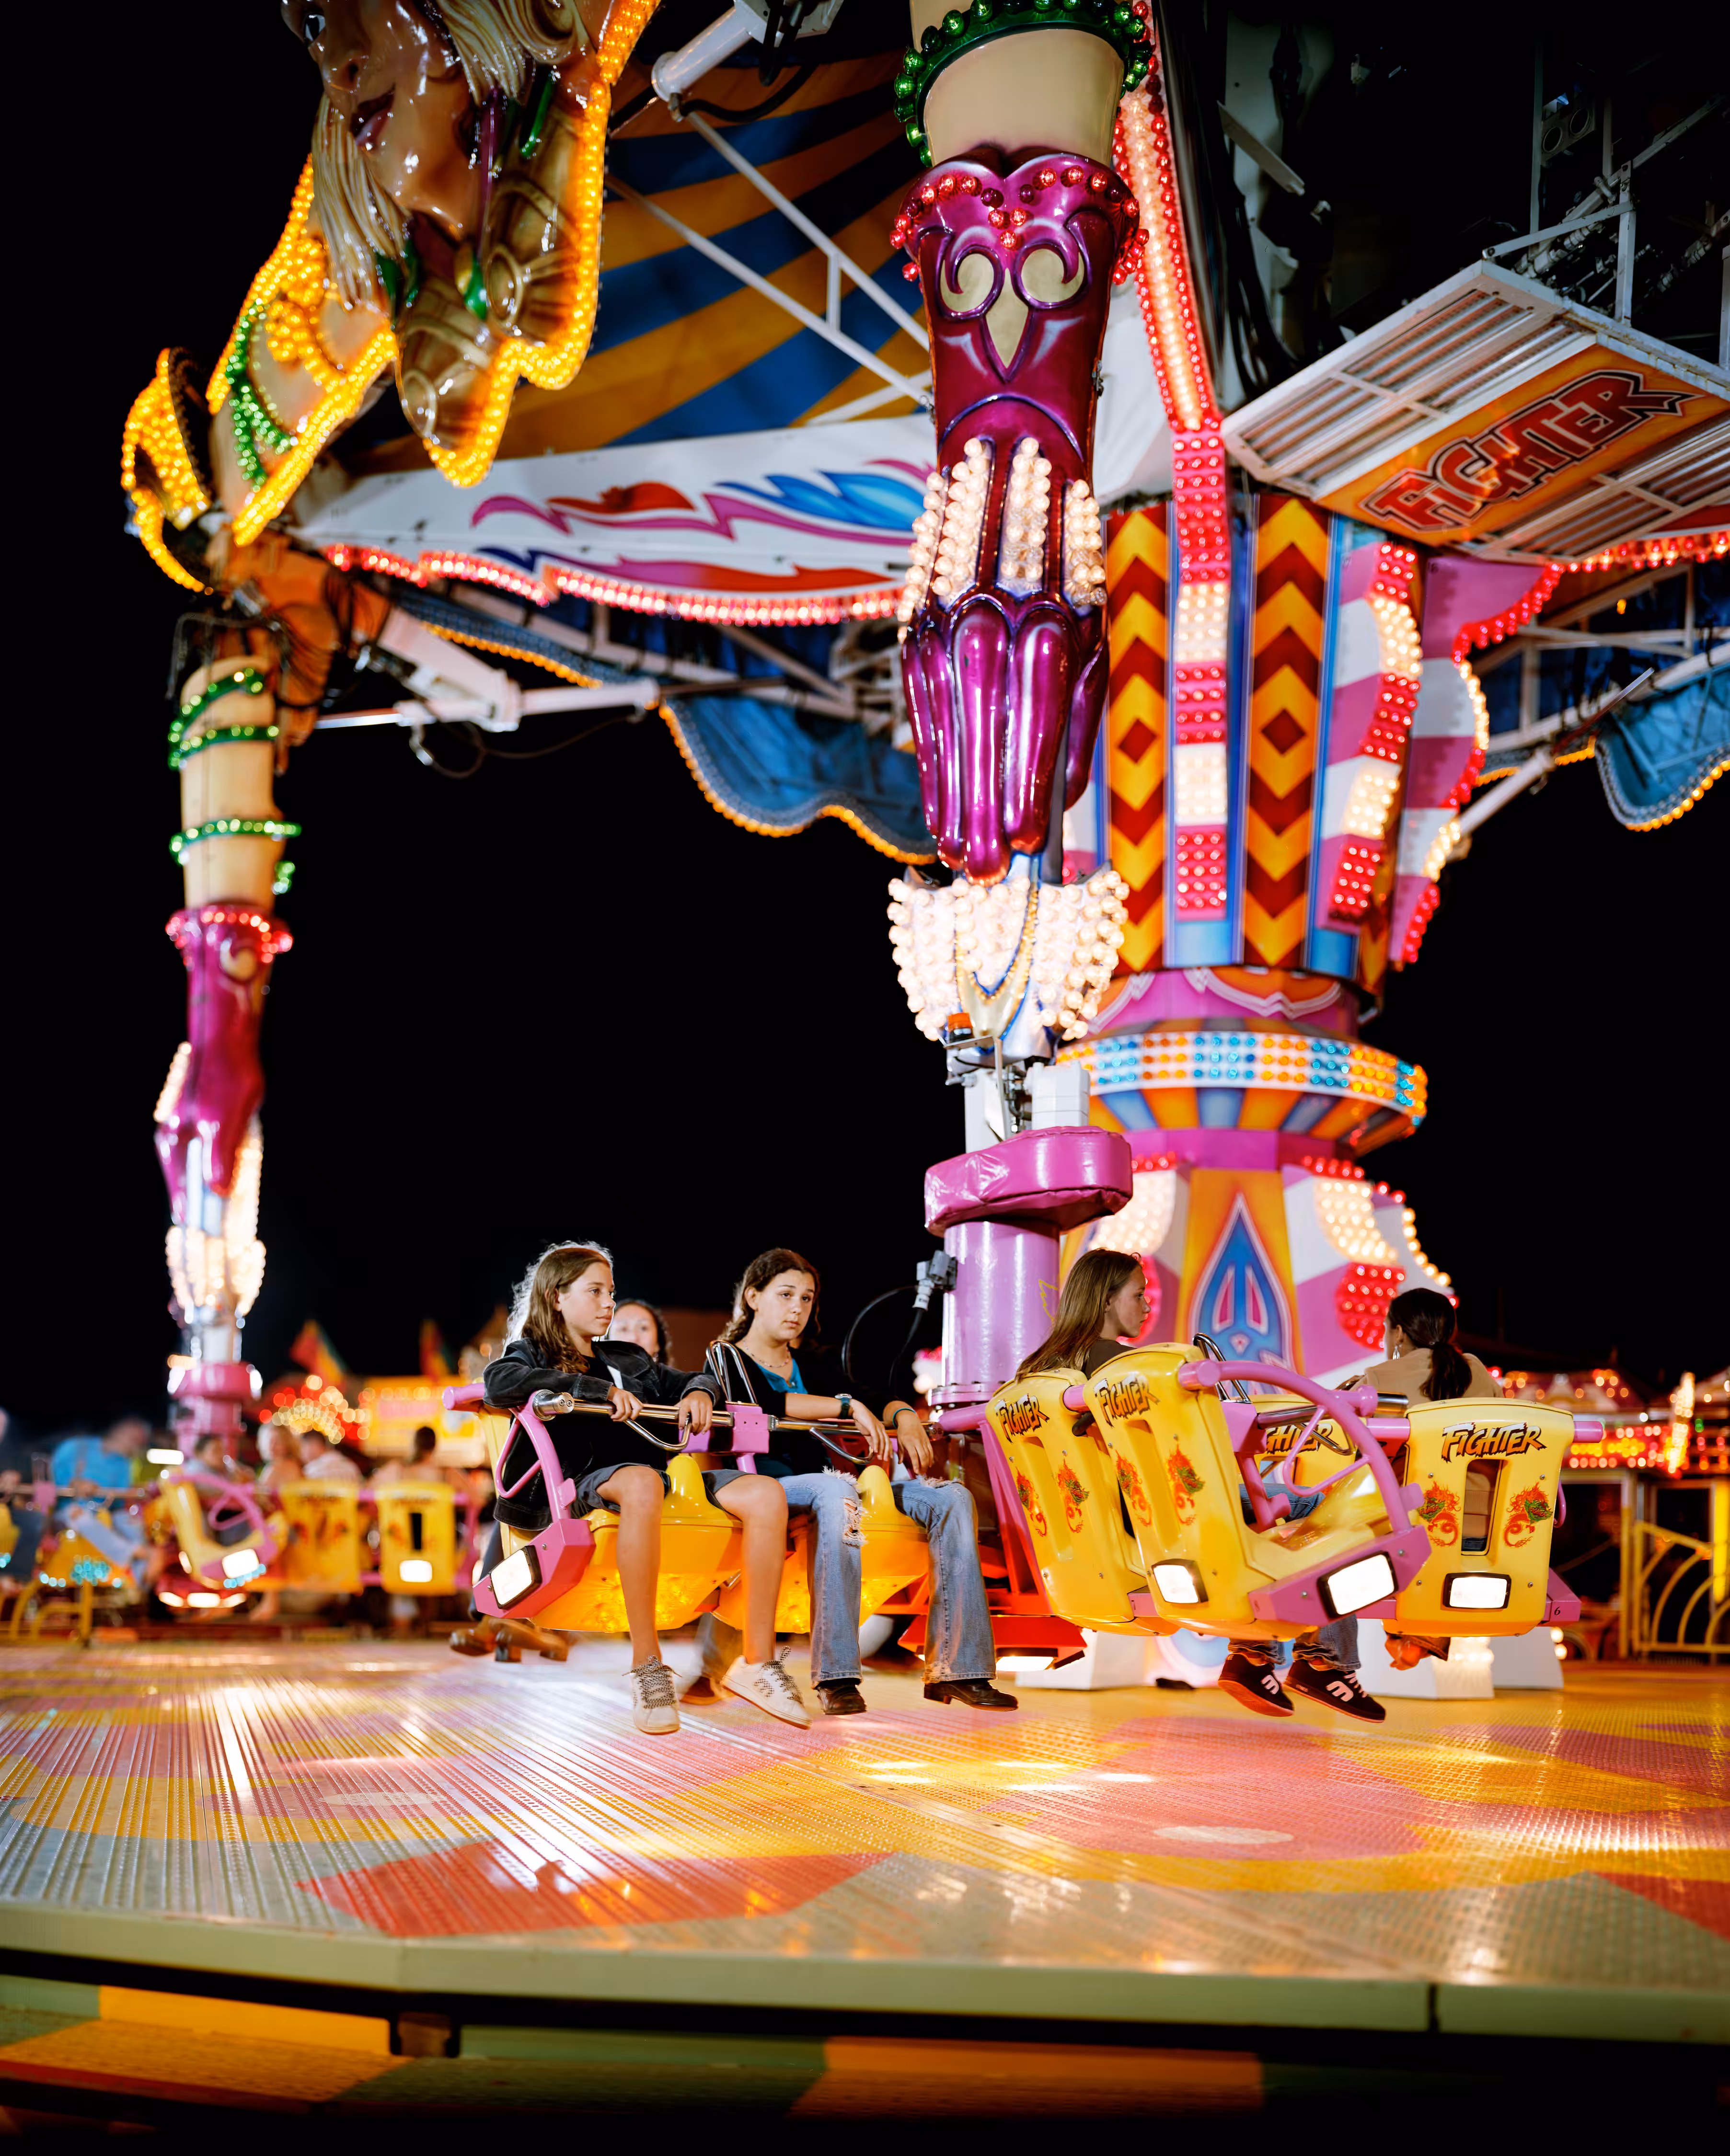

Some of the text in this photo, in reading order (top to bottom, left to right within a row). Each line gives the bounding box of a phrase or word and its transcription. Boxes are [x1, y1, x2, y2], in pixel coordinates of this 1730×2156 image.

[1360, 369, 1705, 531] FIGHTER
[994, 1393, 1050, 1444] FIGHTER
[1094, 1372, 1162, 1428] FIGHTER
[1442, 1422, 1547, 1464] FIGHTER
[1554, 1606, 1561, 1616] 6
